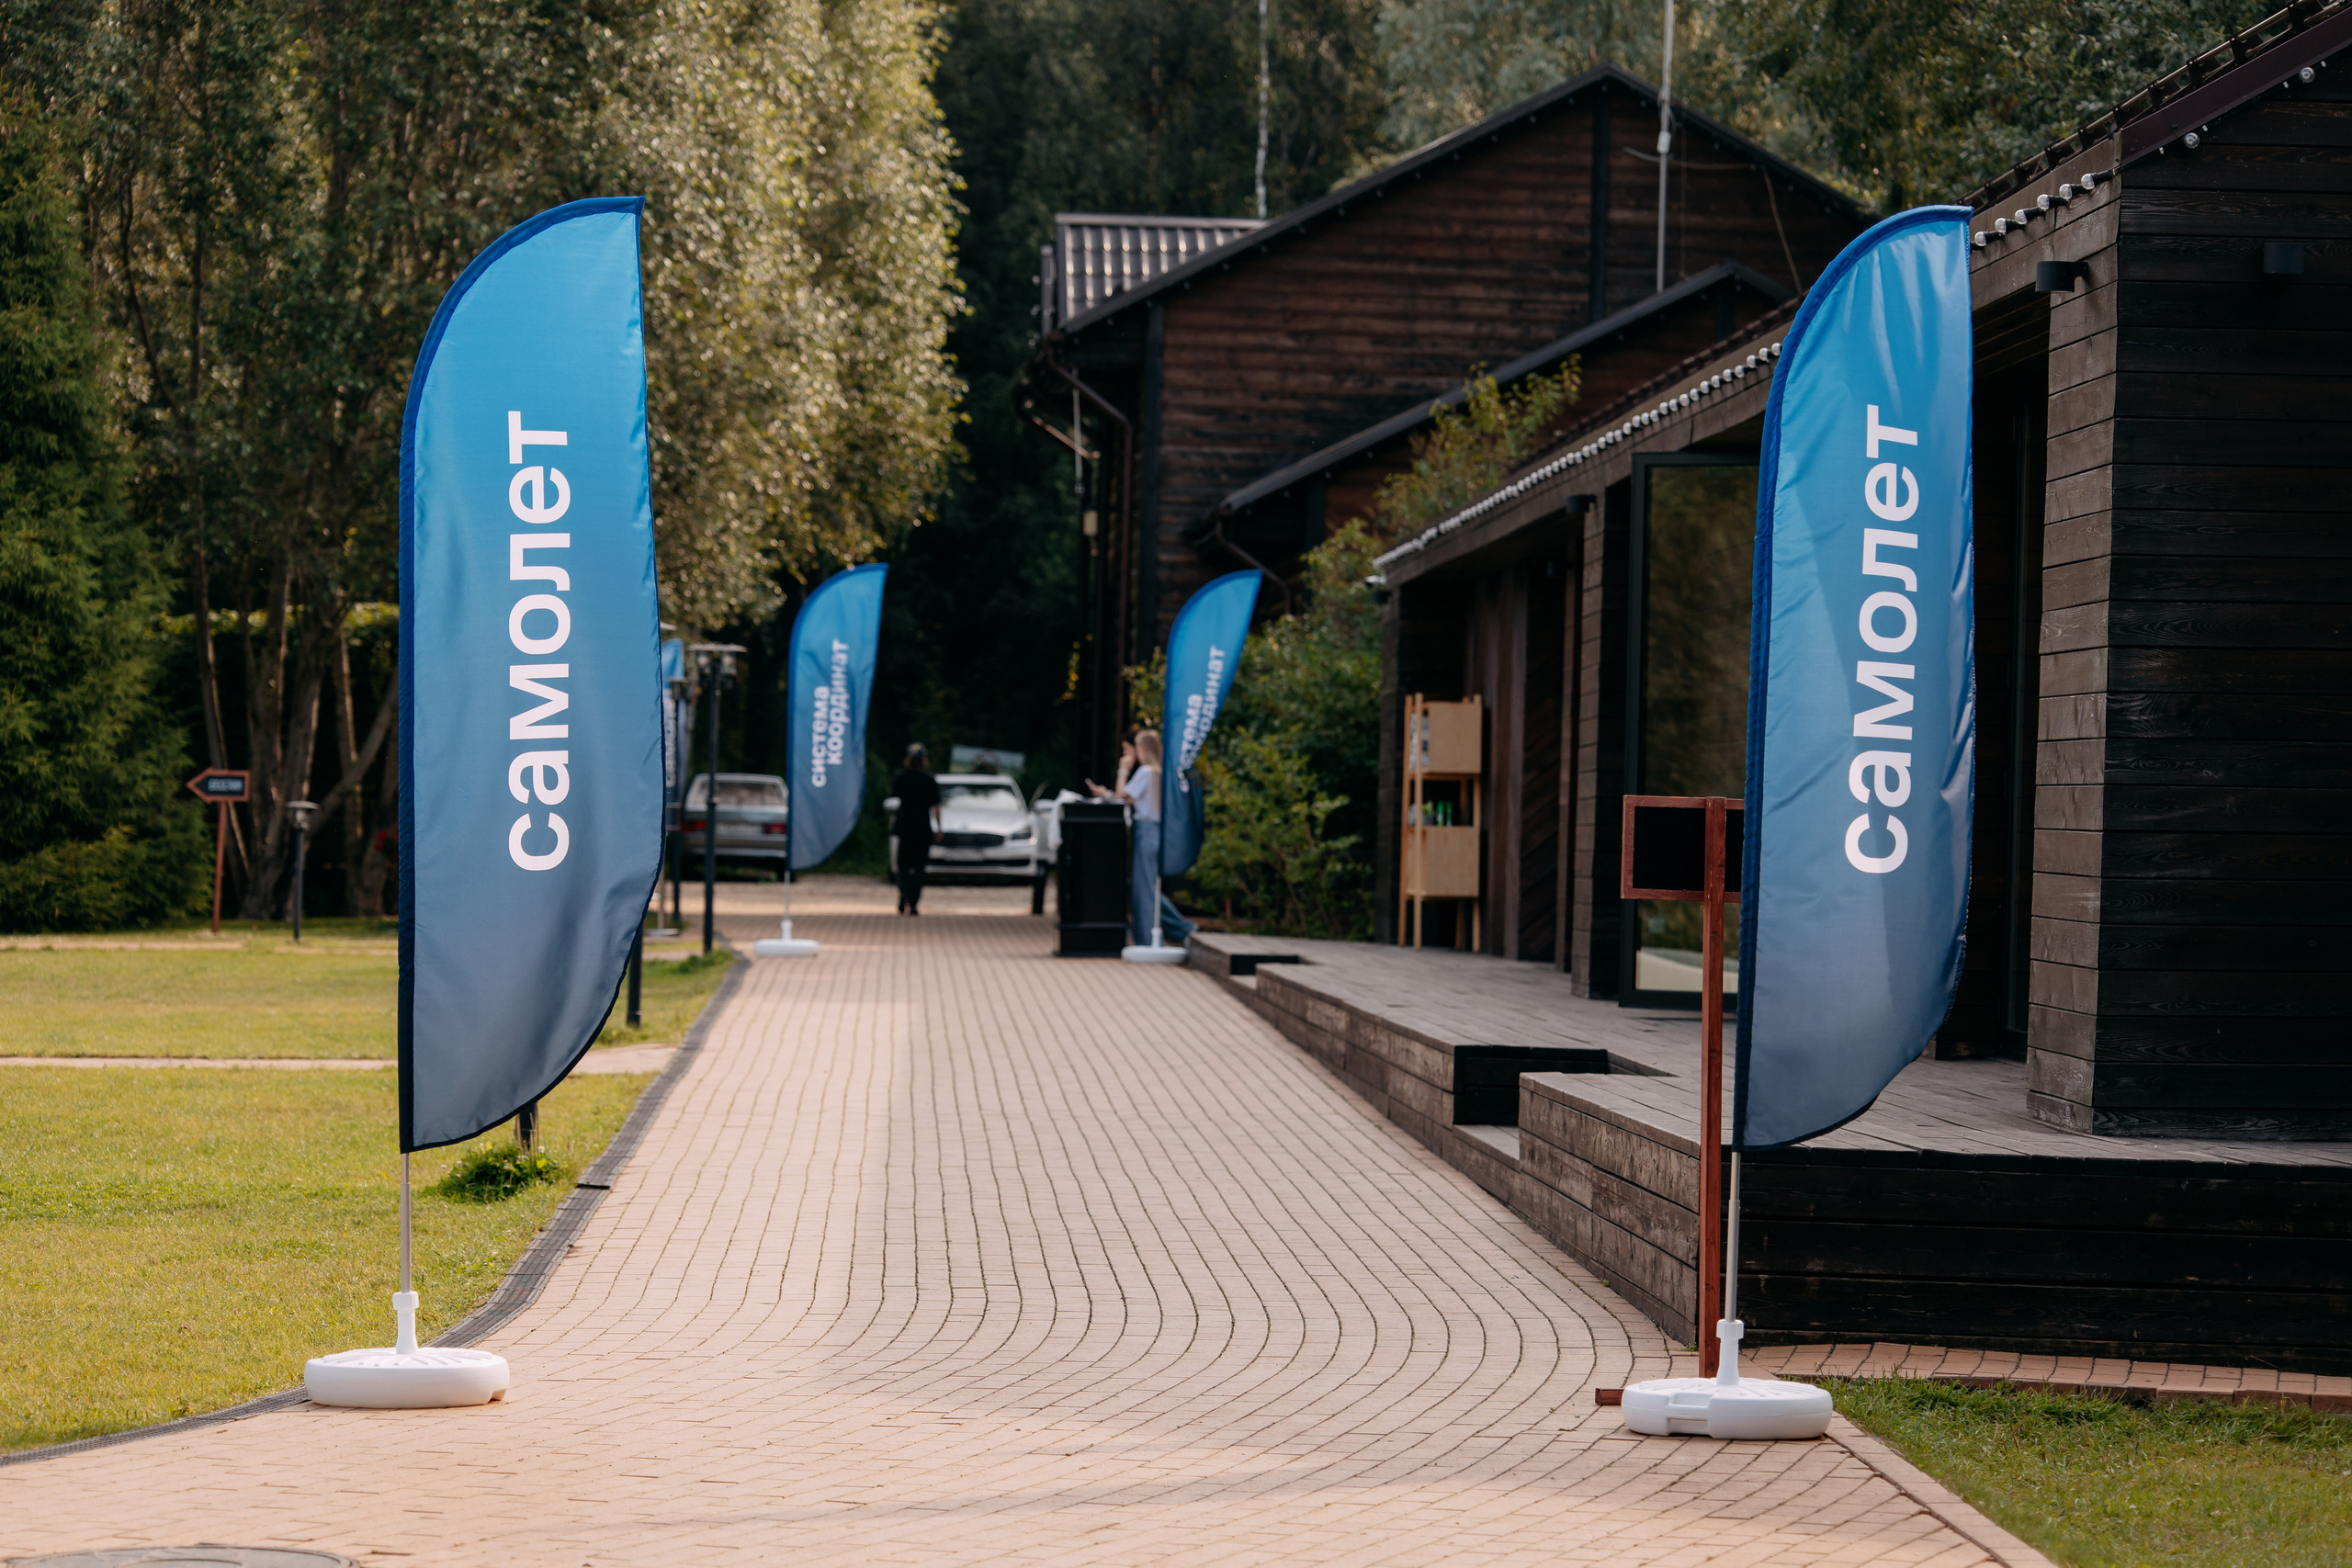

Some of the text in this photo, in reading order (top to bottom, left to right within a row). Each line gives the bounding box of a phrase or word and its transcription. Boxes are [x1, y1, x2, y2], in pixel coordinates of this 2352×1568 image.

[508, 411, 571, 872] самолет
[811, 685, 830, 788] система
[827, 637, 851, 765] координат
[1844, 404, 1919, 874] самолет
